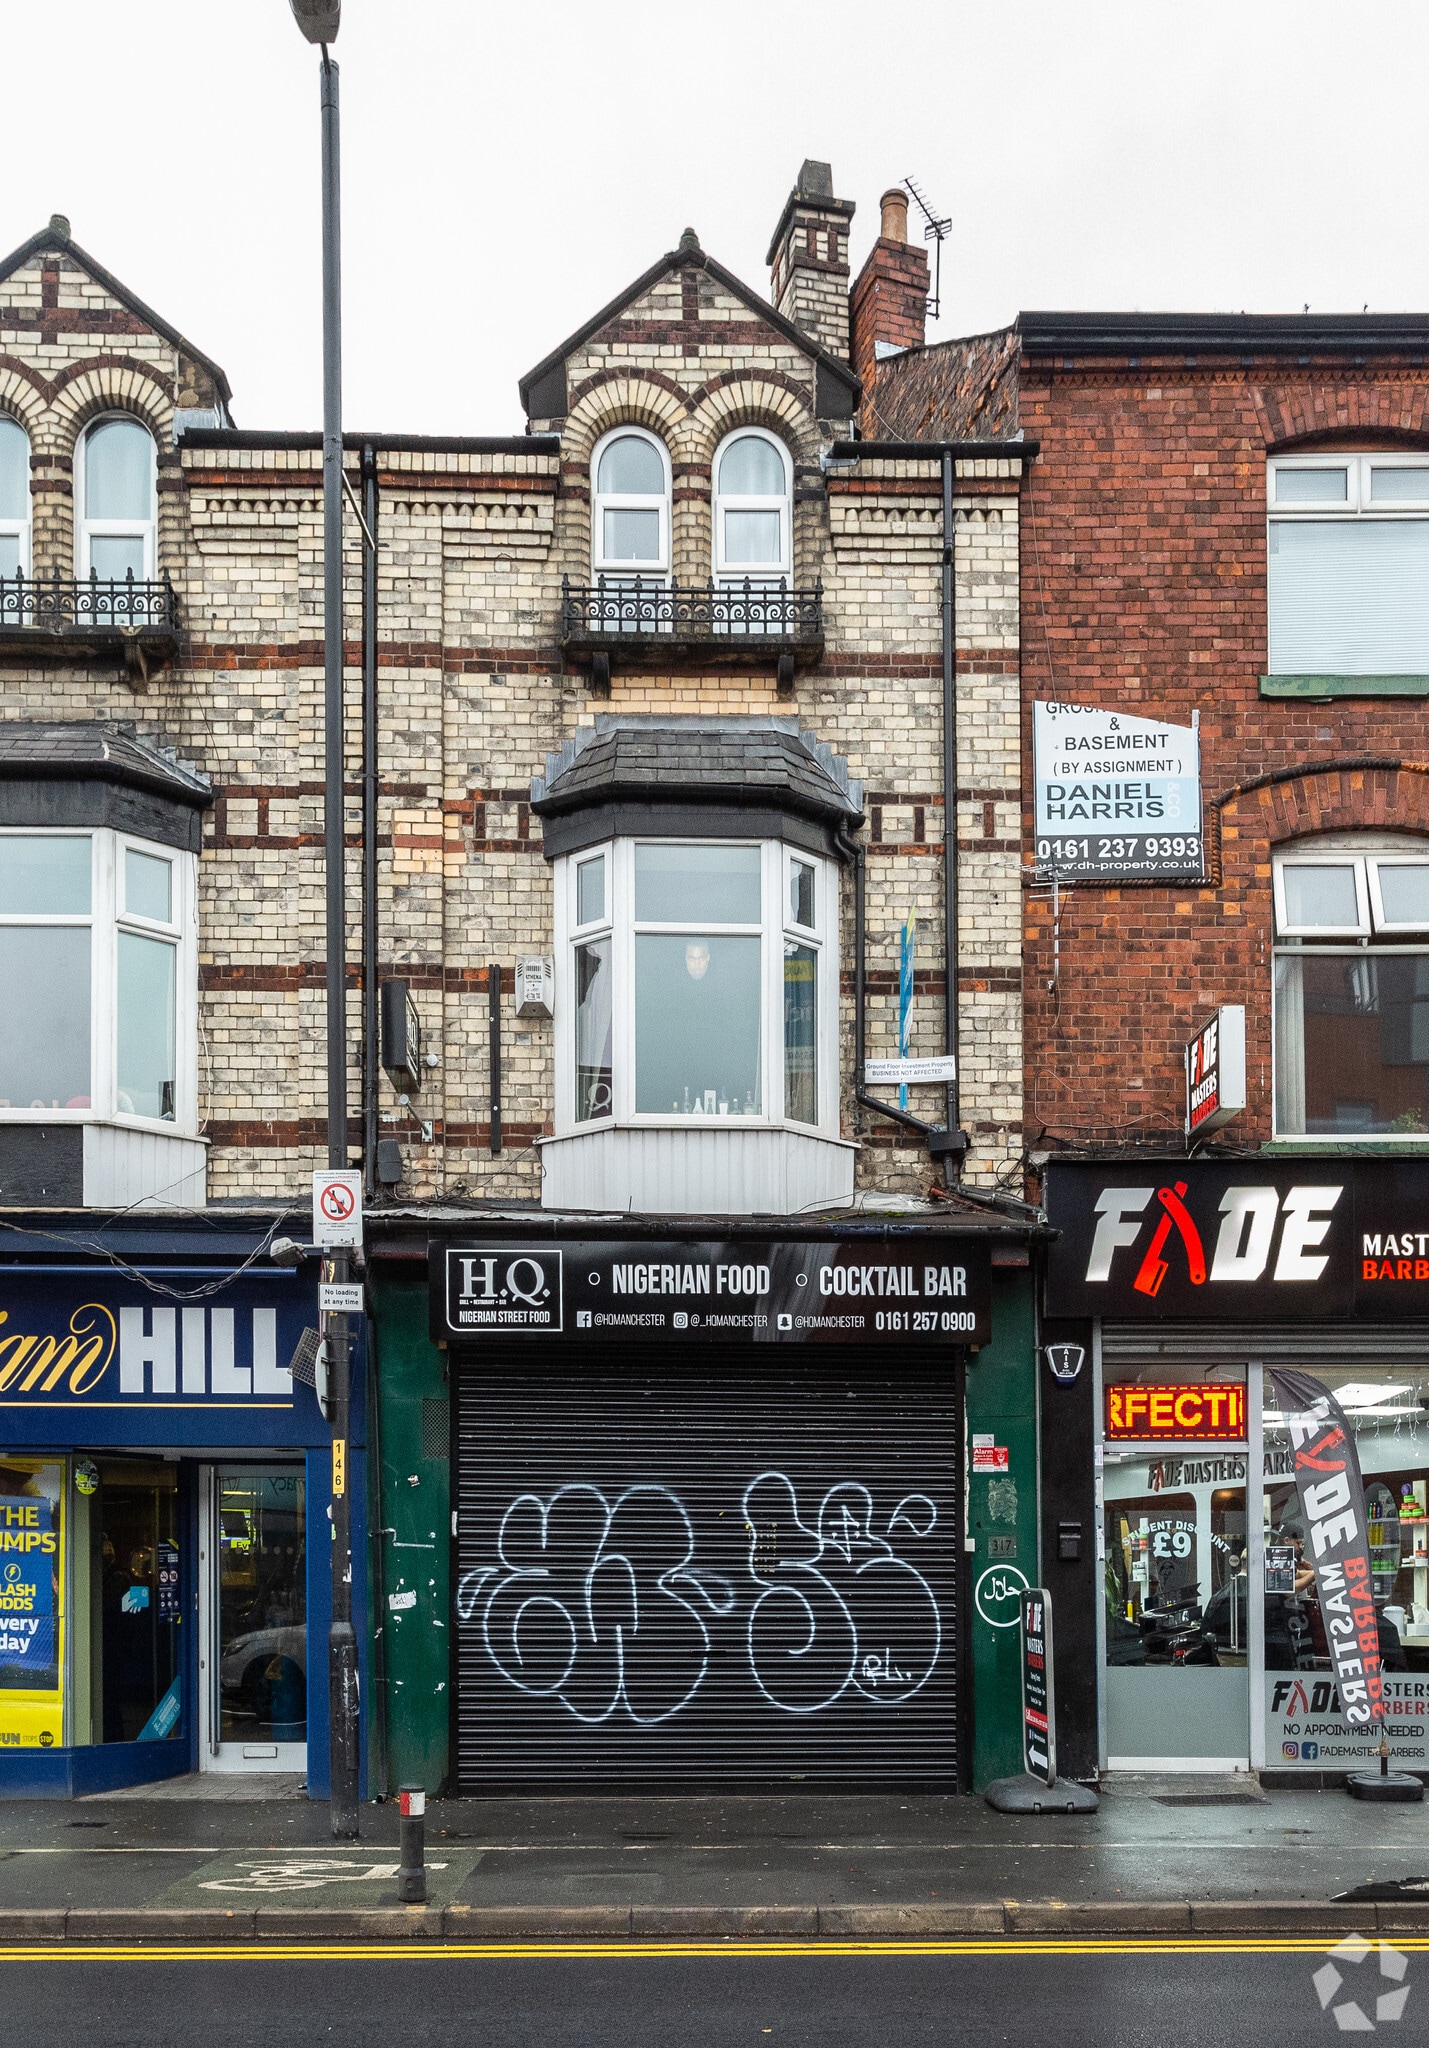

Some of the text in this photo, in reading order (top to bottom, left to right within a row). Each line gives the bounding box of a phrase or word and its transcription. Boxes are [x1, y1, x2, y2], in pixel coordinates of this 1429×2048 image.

[1110, 717, 1120, 731] &
[1065, 734, 1169, 750] BASEMENT
[1061, 762, 1080, 774] BY
[1084, 760, 1174, 774] ASSIGNMENT
[1046, 783, 1163, 801] DANIEL
[1046, 801, 1165, 820] HARRIS
[1038, 837, 1199, 860] 0161 237 9393
[1038, 860, 1200, 872] w.dh-property.co.uk
[1191, 1020, 1218, 1086] FADE
[1192, 1071, 1218, 1111] MASTERS
[1192, 1091, 1218, 1128] BARBERS
[1085, 1181, 1344, 1297] FADE
[1363, 1234, 1429, 1256] MAST
[1363, 1259, 1429, 1280] BARB
[459, 1258, 551, 1306] H.Q.
[612, 1264, 967, 1296] NIGERIAN FOOD COCKTAIL BAR
[459, 1310, 551, 1323] NIGERIAN STREET FOOD
[875, 1311, 909, 1330] 0161
[913, 1311, 938, 1330] 257
[941, 1312, 976, 1331] 0900
[119, 1306, 294, 1394] HILL
[1110, 1393, 1242, 1427] RFECTI
[1184, 1459, 1246, 1485] MASTERS
[0, 1532, 56, 1553] MPS
[992, 1539, 1012, 1551] 317
[1153, 1531, 1191, 1558] £9
[0, 1597, 33, 1611] DDS
[1027, 1636, 1044, 1655] MASTERS
[0, 1733, 21, 1745] UN
[40, 1735, 53, 1743] STOP
[1284, 1724, 1300, 1735] NO
[1382, 1725, 1424, 1737] NEEDED
[1320, 1746, 1426, 1757] FADEMASTEARBERS
